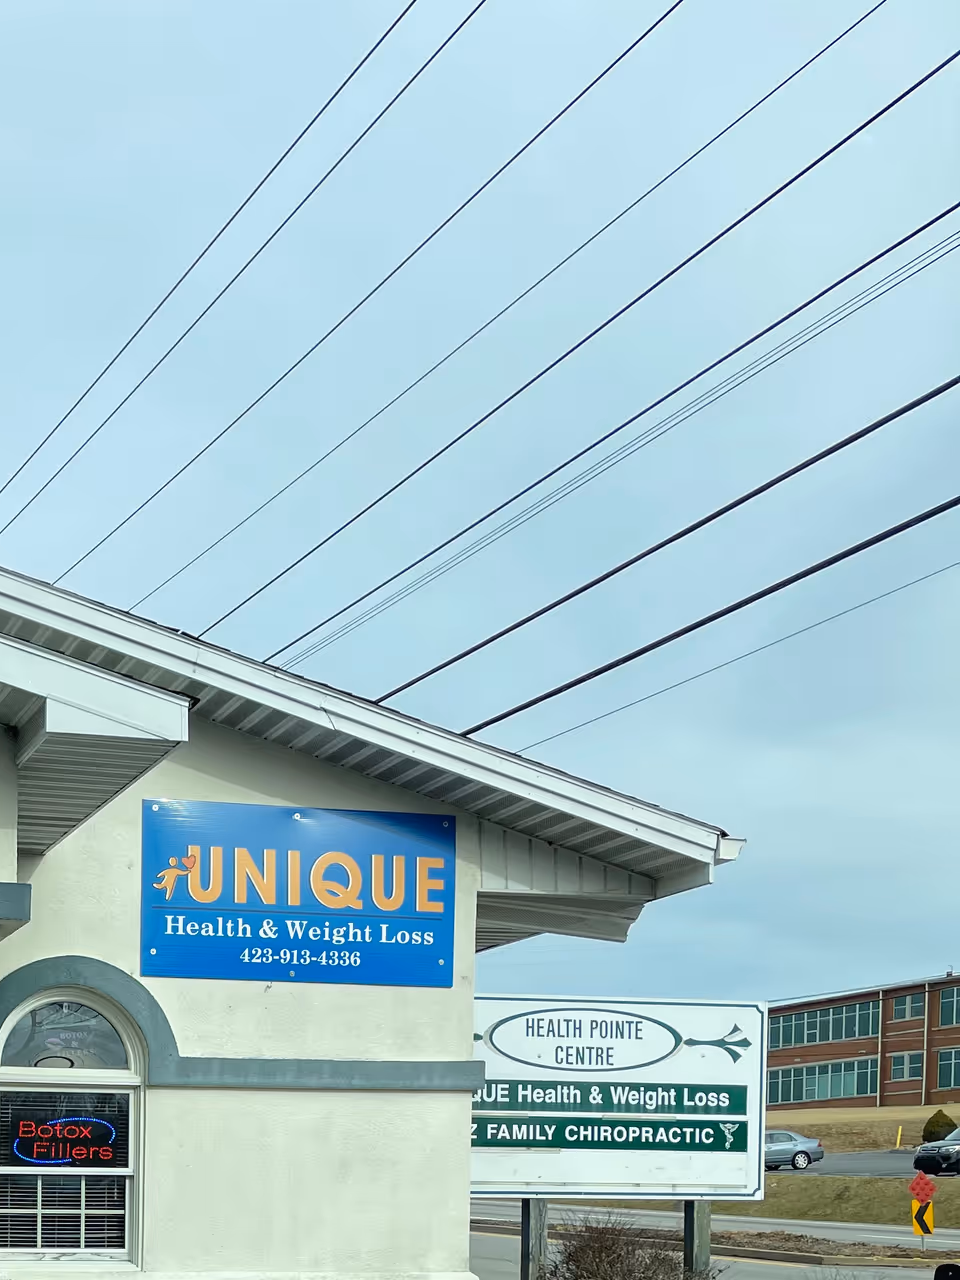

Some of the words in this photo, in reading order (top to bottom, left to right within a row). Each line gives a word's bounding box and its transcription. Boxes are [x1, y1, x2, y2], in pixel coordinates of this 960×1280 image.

[187, 844, 445, 914] UNIQUE
[164, 915, 253, 939] Health
[258, 919, 279, 940] &
[284, 919, 373, 945] Weight
[378, 923, 435, 946] Loss
[239, 947, 362, 967] 423-913-4336
[525, 1017, 583, 1039] HEALTH
[589, 1019, 644, 1040] POINTE
[554, 1045, 615, 1066] CENTRE
[517, 1084, 581, 1104] Health
[589, 1085, 604, 1105] &
[610, 1086, 677, 1109] Weight
[682, 1087, 730, 1107] Loss
[18, 1120, 93, 1139] Botox
[486, 1123, 557, 1141] FAMILY
[564, 1124, 715, 1144] CHIROPRACTIC
[33, 1141, 113, 1160] Fillers
